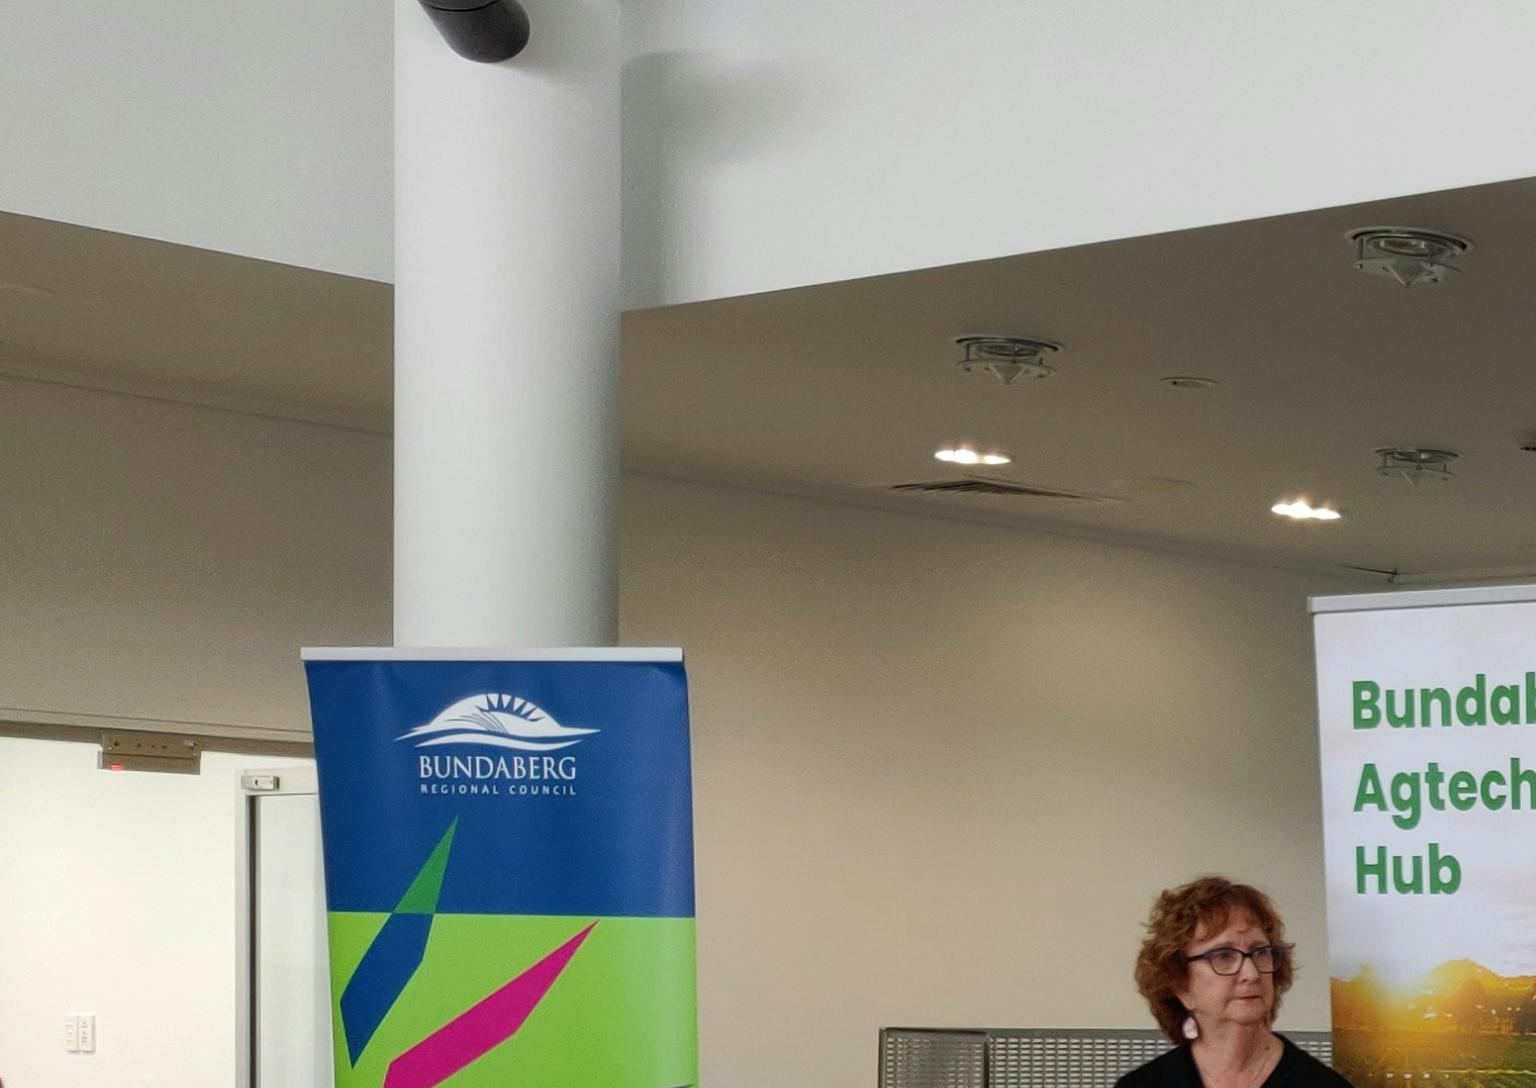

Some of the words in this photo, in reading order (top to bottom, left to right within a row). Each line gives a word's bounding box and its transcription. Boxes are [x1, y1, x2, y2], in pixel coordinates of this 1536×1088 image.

[419, 756, 577, 780] BUNDABERG
[420, 784, 499, 795] REGIONAL
[509, 785, 577, 796] COUNCIL
[1355, 843, 1462, 895] Hub
